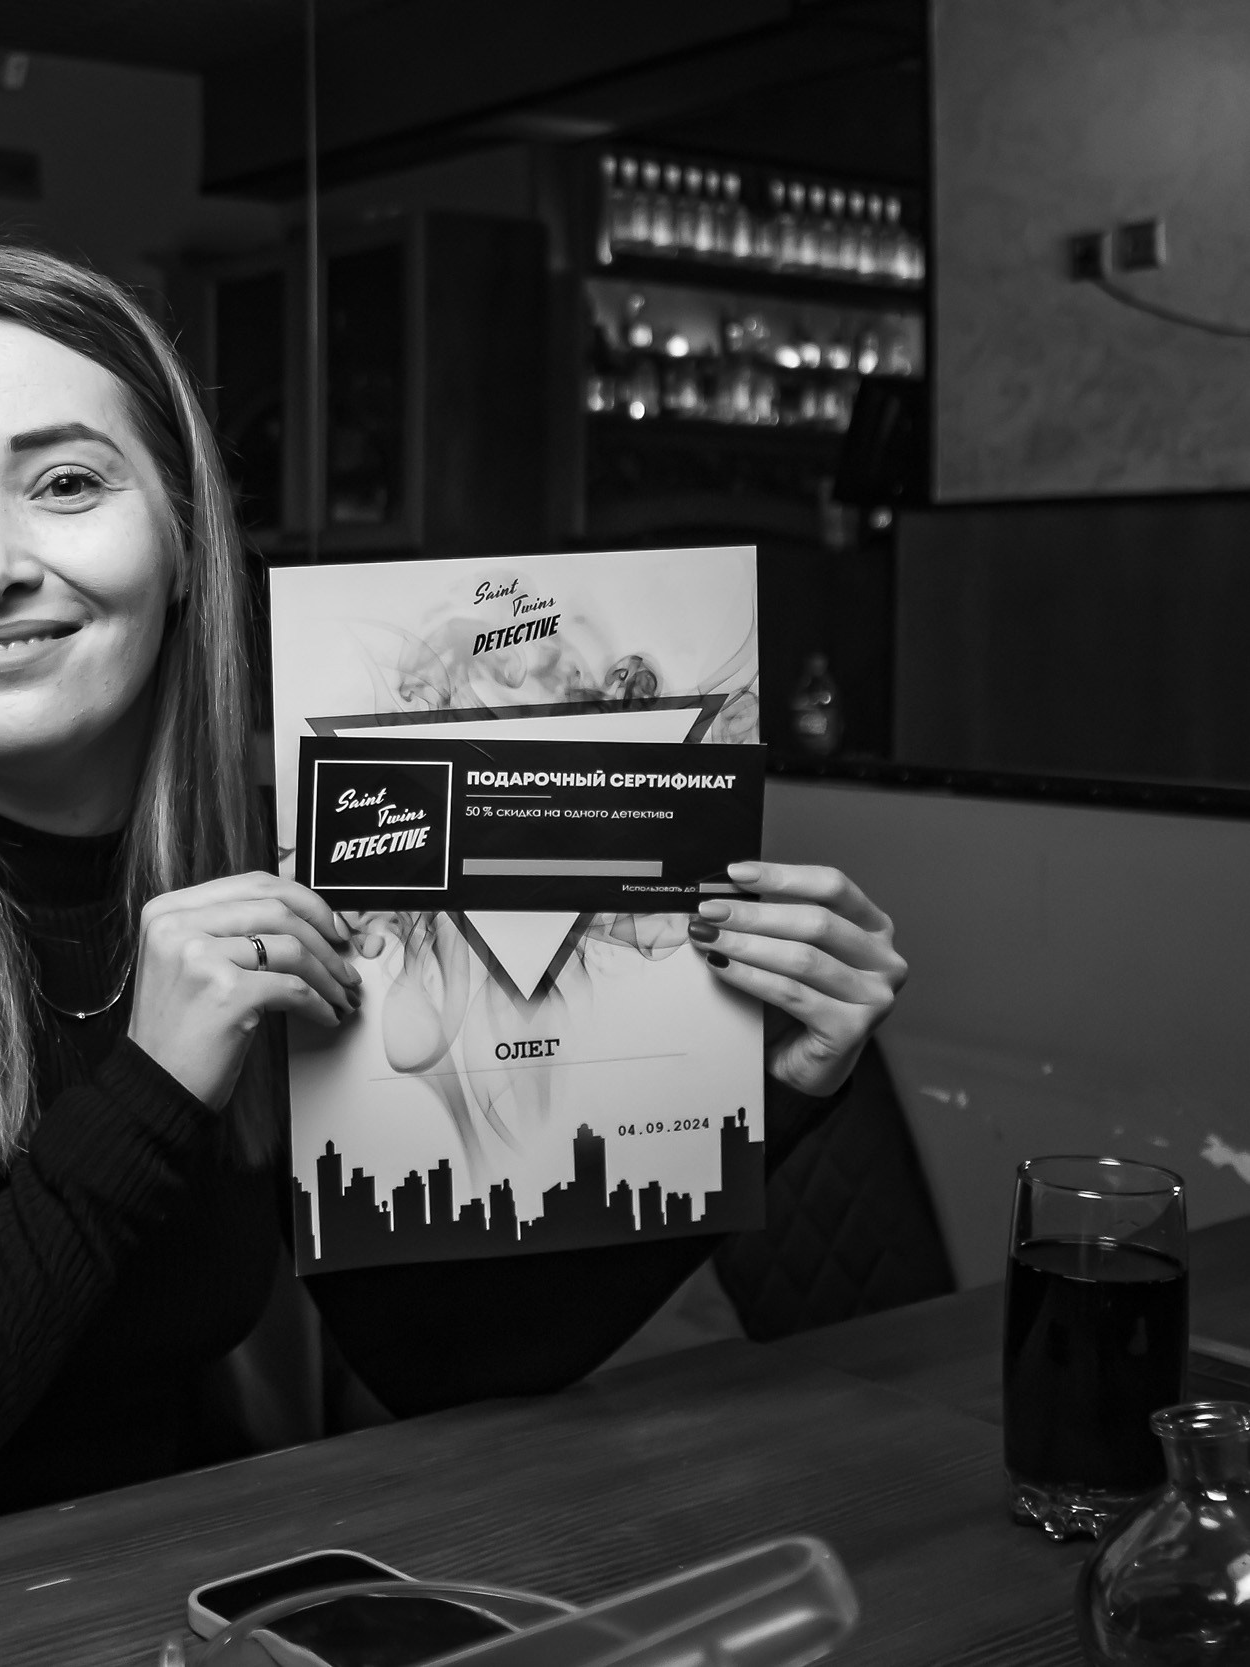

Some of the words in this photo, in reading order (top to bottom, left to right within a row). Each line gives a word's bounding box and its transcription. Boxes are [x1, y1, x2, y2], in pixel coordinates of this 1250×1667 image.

[473, 578, 519, 605] Saint
[512, 593, 557, 617] Twins
[472, 613, 561, 656] DETECTIVE
[466, 769, 606, 788] ПОДАРОЧНЫЙ
[609, 772, 736, 791] СЕРТИФИКАТ
[335, 787, 387, 813] Saint
[377, 803, 427, 828] Twins
[465, 806, 481, 817] 50
[482, 806, 494, 818] %
[495, 808, 541, 819] скидка
[544, 809, 561, 818] на
[564, 809, 609, 819] одного
[610, 810, 674, 820] детектива
[330, 825, 431, 864] DETECTIVE
[622, 884, 683, 894] Использовать
[494, 1037, 560, 1061] ОЛЕГ
[618, 1117, 710, 1137] 04.09.2024
